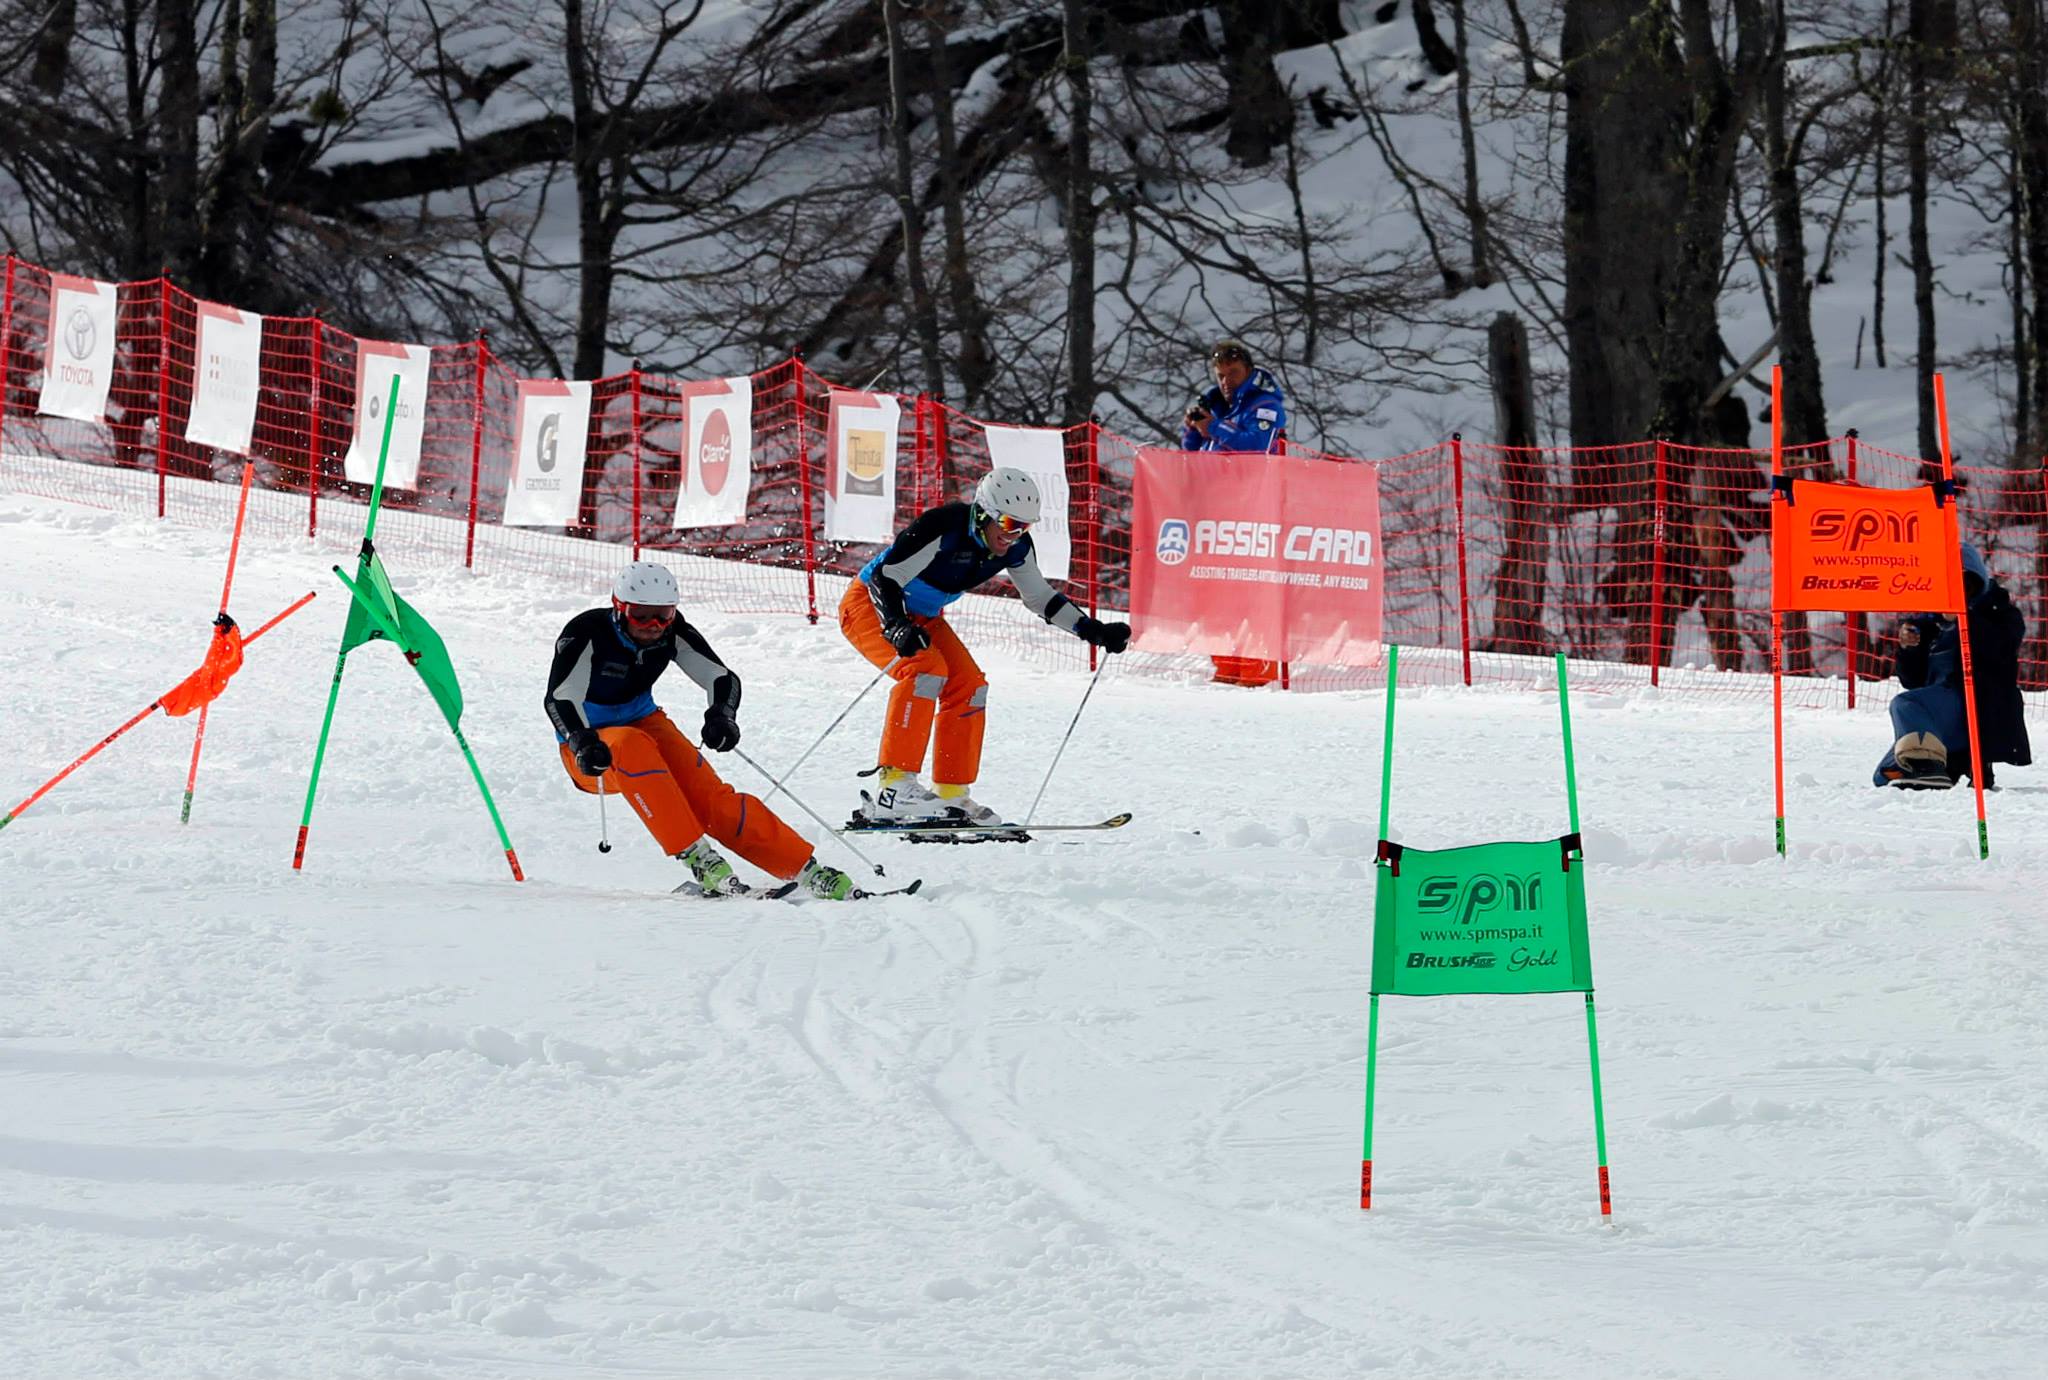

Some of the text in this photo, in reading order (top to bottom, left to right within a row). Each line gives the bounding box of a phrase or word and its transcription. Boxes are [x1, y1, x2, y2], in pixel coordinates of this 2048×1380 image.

[60, 364, 94, 387] TOYOTA
[702, 443, 726, 463] Claro
[1195, 519, 1372, 567] ASSIST CARD
[1813, 554, 1920, 569] www.spmspa.it
[1888, 573, 1933, 595] Gold
[1420, 924, 1544, 943] www.spmspa.it
[1506, 947, 1559, 972] Gold
[1361, 1166, 1372, 1198] SPM
